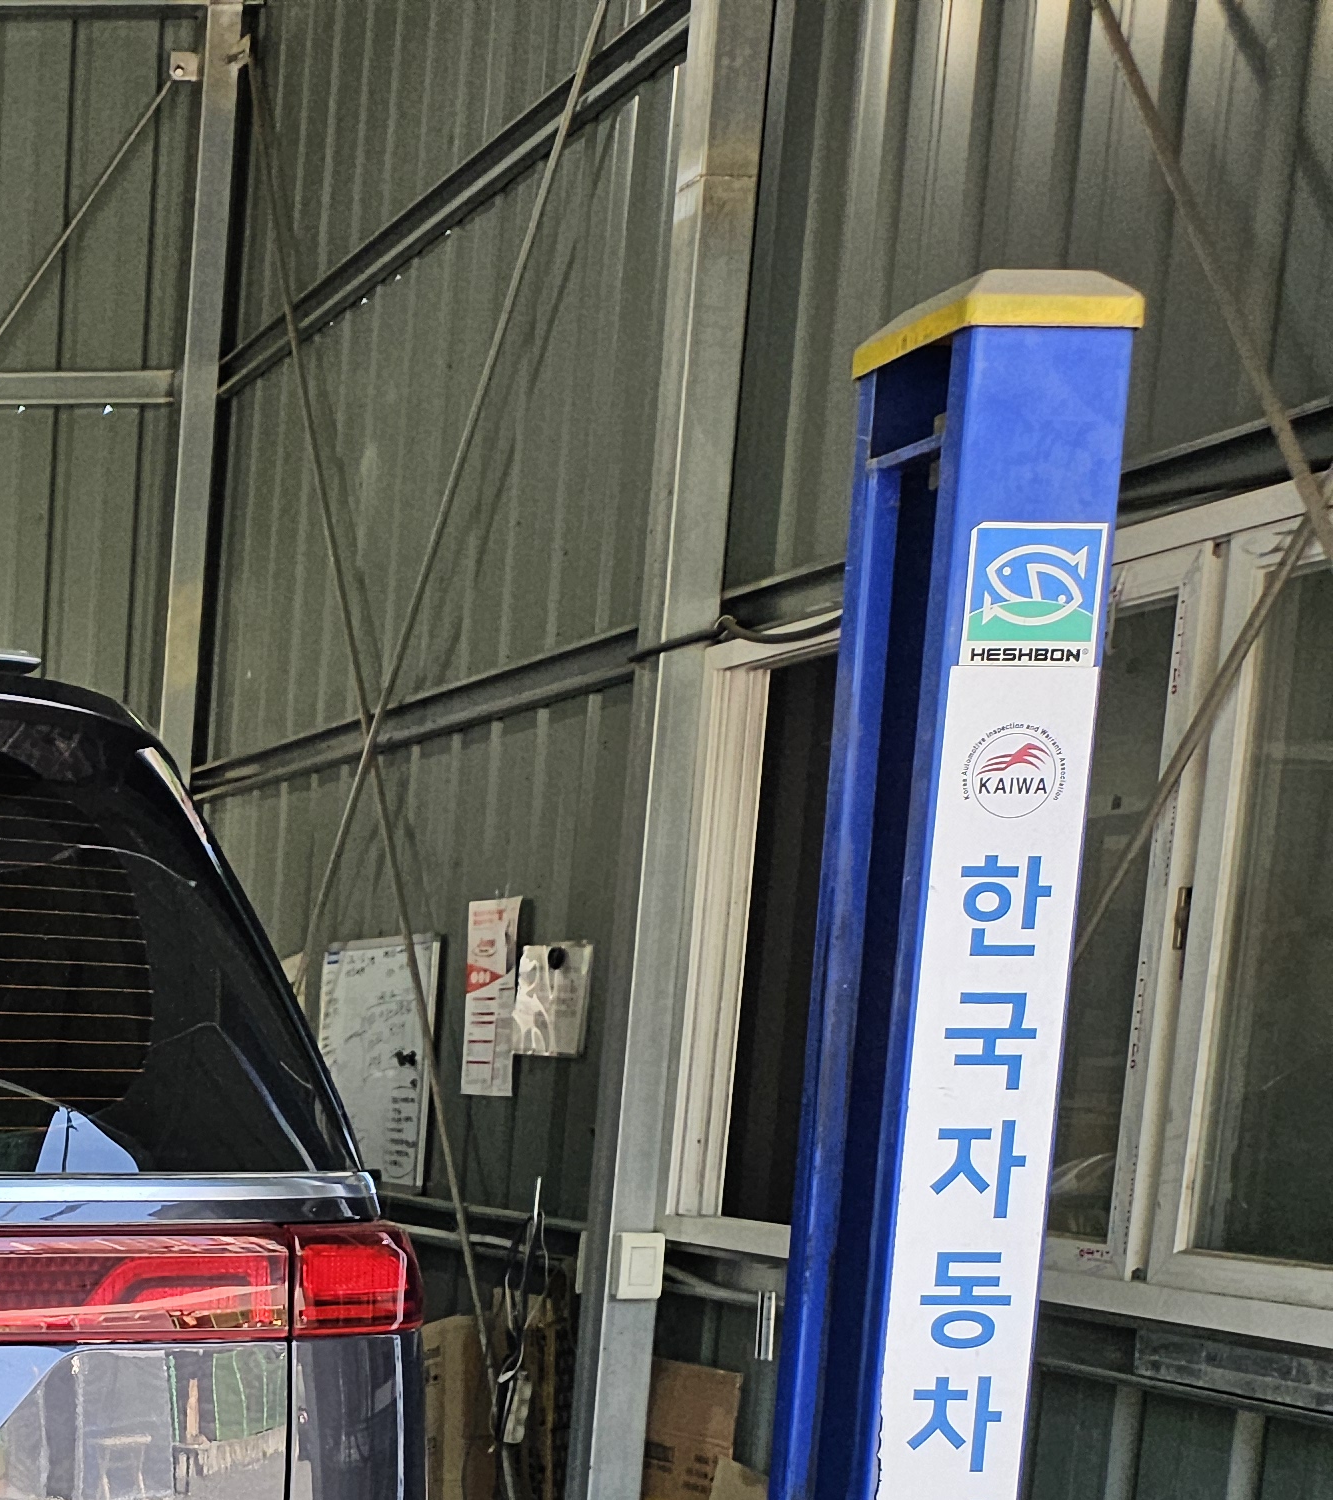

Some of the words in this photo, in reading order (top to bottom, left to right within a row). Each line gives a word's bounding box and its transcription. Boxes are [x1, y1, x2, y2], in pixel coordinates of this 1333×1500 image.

[970, 647, 1081, 662] HESHBON
[961, 737, 986, 776] Automotive
[986, 722, 1024, 738] Inspection
[1040, 728, 1062, 756] Warranty
[1053, 757, 1066, 801] Association
[978, 777, 1047, 795] KAIWA
